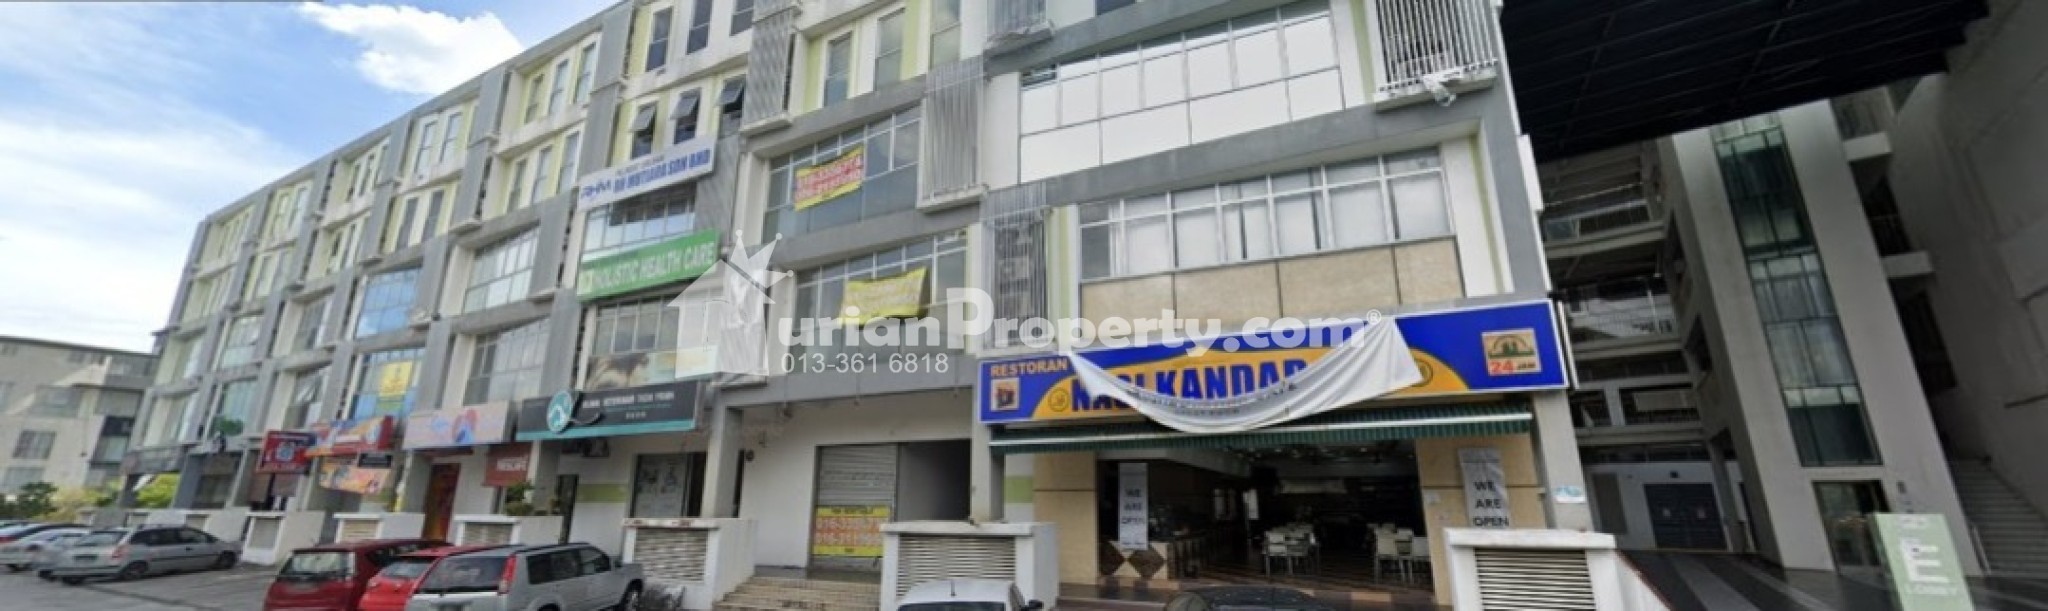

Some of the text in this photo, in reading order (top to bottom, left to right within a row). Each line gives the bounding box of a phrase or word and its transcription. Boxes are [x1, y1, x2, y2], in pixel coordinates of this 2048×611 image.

[640, 249, 682, 280] HEALTH
[684, 241, 716, 270] CARE
[990, 358, 1069, 378] RESTORAN
[1488, 358, 1514, 376] 24
[1475, 498, 1502, 509] ARE
[1472, 516, 1510, 527] OPEN
